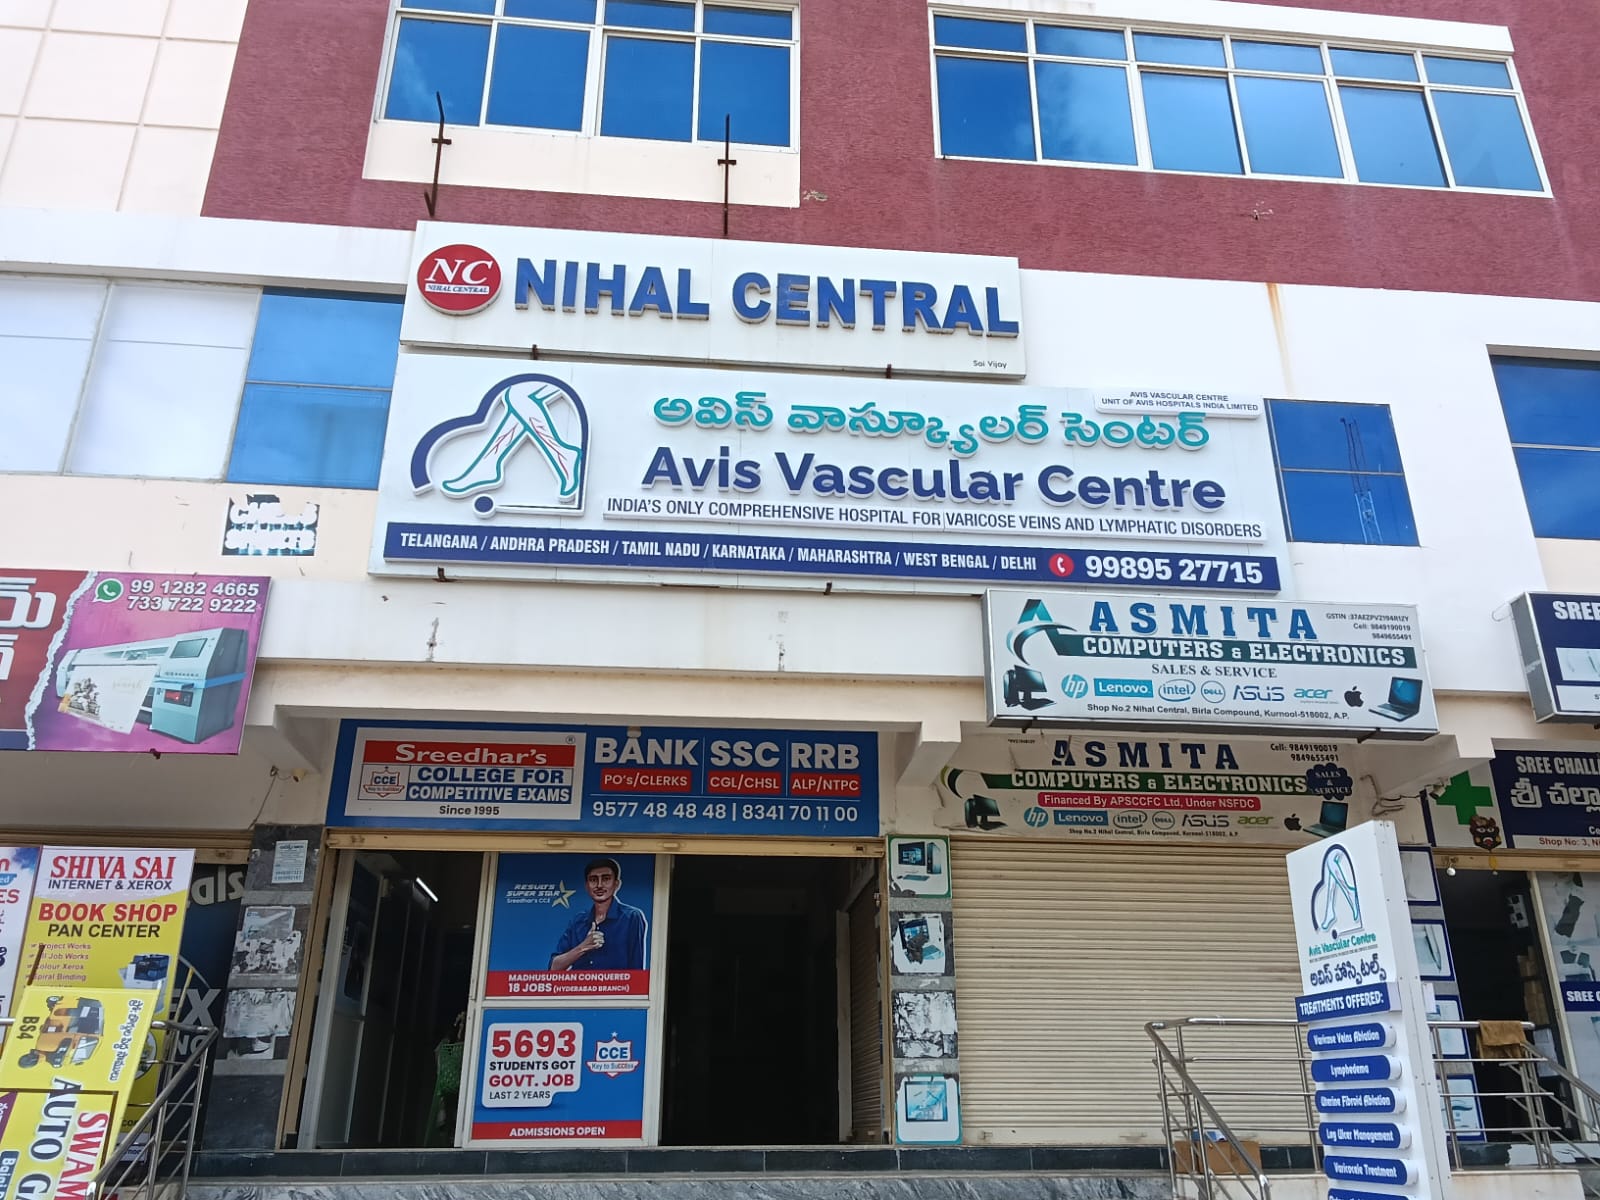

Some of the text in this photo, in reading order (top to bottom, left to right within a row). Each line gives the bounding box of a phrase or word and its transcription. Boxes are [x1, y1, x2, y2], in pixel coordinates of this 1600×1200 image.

[424, 258, 493, 284] NC
[514, 257, 1019, 336] NIHAL CENTRAL
[1136, 399, 1154, 407] AVIS
[1156, 400, 1201, 409] HOSPITALS
[1226, 403, 1258, 411] LIMITED
[1150, 392, 1193, 400] VASCULAR
[1195, 394, 1228, 402] CENTRE
[654, 391, 773, 429] అవిస్
[1062, 411, 1209, 448] సెంటర్
[641, 446, 1226, 510] Avis Vascular Centre
[607, 498, 1262, 538] INDIA'S ONLY COMPREHENSIVE HOSPITAL FOR VARICOSE VEINS AND LYMPHATIC DISORDERS
[400, 533, 1263, 584] TELANGANA ANDHRA PRADESH TAMIL NADU KARNATAKA MAHARASHTRA WEST BENGAL DELHI 99895 27715
[130, 579, 259, 597] 99 1282 4665
[127, 596, 257, 614] 733 722 9222
[1089, 600, 1318, 640] ASMITA
[1083, 637, 1406, 665] COMPUTERS & ELECTRONICS
[1151, 663, 1277, 678] SALES & SERVICE
[1063, 674, 1333, 701] hp Lenovo ASUS acer
[1087, 703, 1349, 720] Shop No.2 Nihal Birla Compound, A.P.
[396, 744, 547, 764] Sreedhar's
[594, 737, 860, 769] BANK SSC RRB
[1289, 743, 1338, 752] 9849190019
[1290, 753, 1339, 762] 9849655491
[1515, 755, 1553, 774] SREE
[374, 776, 396, 785] CCE
[417, 766, 564, 784] COLLEGE FOR
[604, 773, 859, 791] PO's/CLERKS CGL/CHSL ALP/NTPC
[1011, 771, 1308, 793] COMPUTERS ELECTRONICS
[408, 785, 570, 802] COMPETITIVE EXAMS
[1045, 795, 1255, 808] Financed By APSCCFC Under NSFDC
[1510, 777, 1543, 808] శ్రీ
[439, 805, 500, 816] Since 1995
[592, 802, 858, 822] 9577 48 48 48 8341 70 11 00
[1025, 807, 1274, 827] hp Lenovo ASUS acer
[1538, 837, 1562, 846] Shop
[50, 856, 176, 879] SHIVA SAI
[48, 879, 172, 890] INTERNET & XEROX
[38, 903, 178, 922] BOOK SHOP
[47, 923, 161, 938] PAN CENTER
[1321, 933, 1376, 953] Vascular Centre
[578, 973, 631, 981] CONQUERED
[508, 983, 629, 993] 18 JOBS (HYDERABAD BRANCH)
[1566, 990, 1595, 1002] SREE
[1299, 991, 1384, 1016] TREATMENTS OFFERED:
[17, 1016, 40, 1041] BS4
[492, 1029, 576, 1058] 5693
[598, 1047, 629, 1059] CCE
[489, 1060, 576, 1070] STUDENTS GOT
[489, 1074, 574, 1087] GOVT. JOB
[489, 1091, 551, 1100] LAST 2 YEARS
[1341, 1095, 1362, 1107] Fibroid
[31, 1078, 82, 1160] AUTO
[509, 1126, 606, 1137] ADMISSIONS OPEN
[1353, 1129, 1394, 1143] Management
[1363, 1163, 1397, 1178] Treatment
